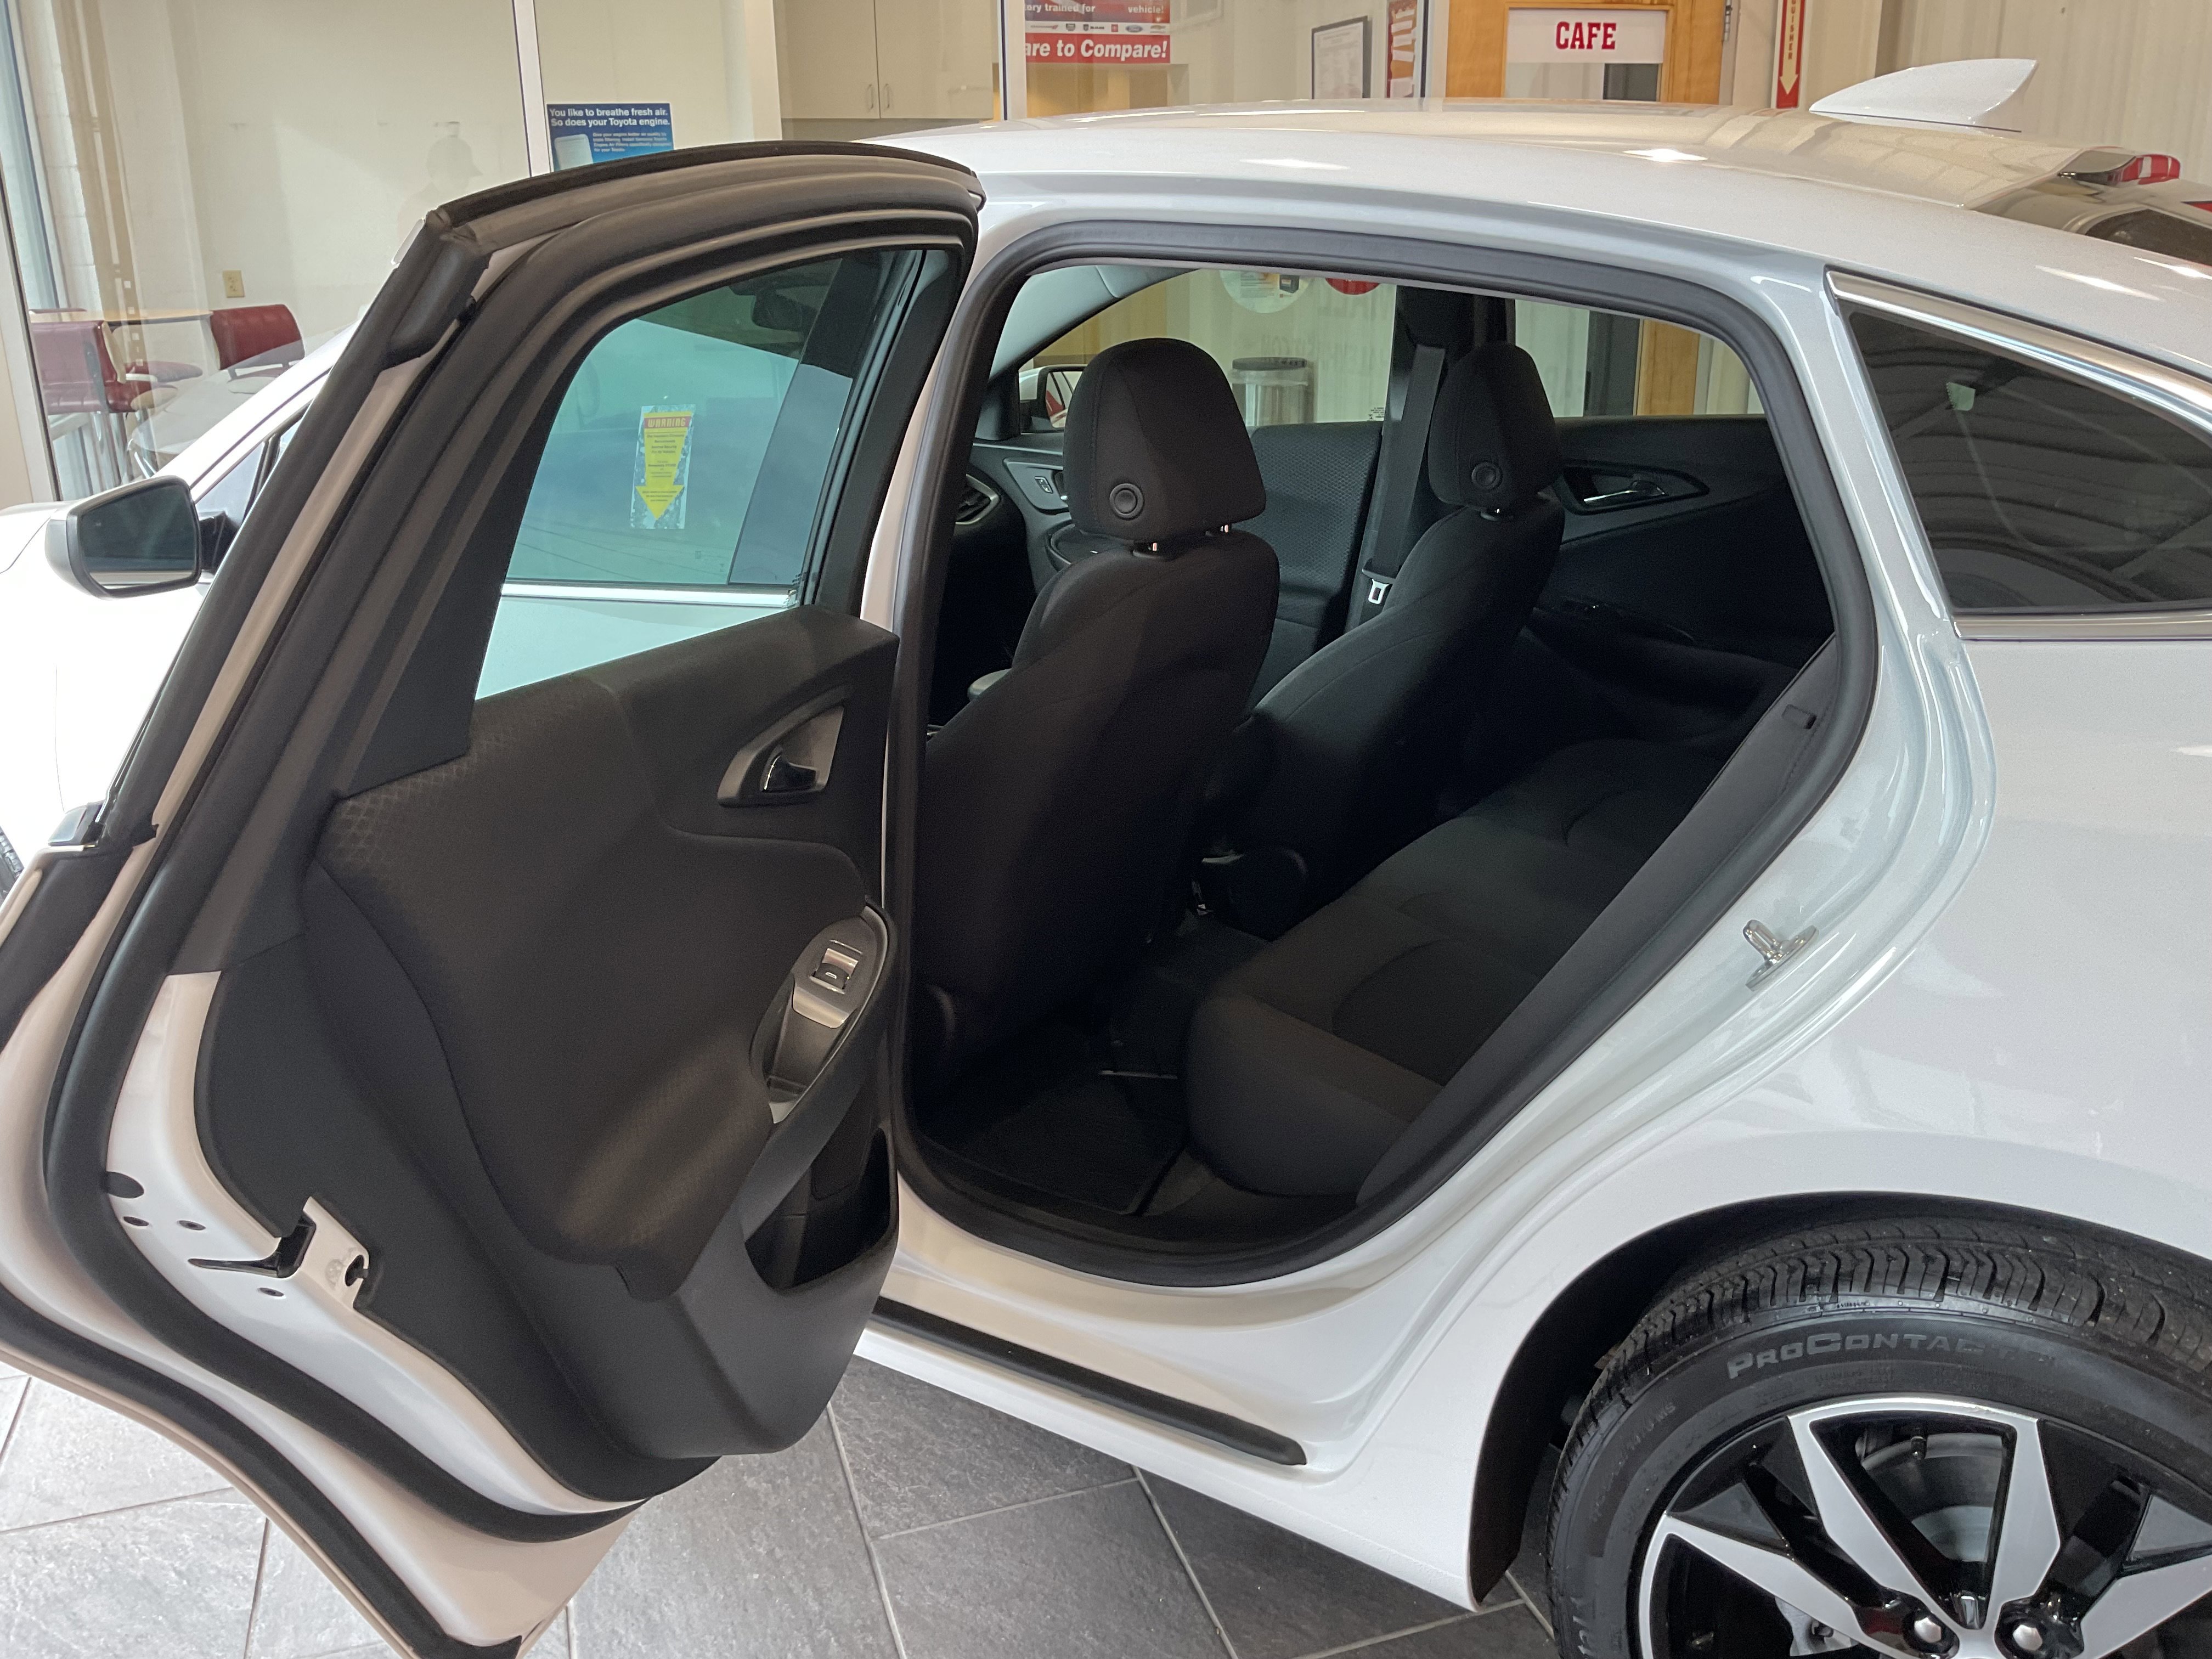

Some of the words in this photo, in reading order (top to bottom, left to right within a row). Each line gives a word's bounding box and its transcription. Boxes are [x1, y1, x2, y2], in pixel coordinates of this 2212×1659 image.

[1045, 3, 1079, 12] trained
[1082, 4, 1096, 12] for
[1128, 5, 1164, 14] vehicle!
[1556, 21, 1616, 49] CAFE
[1057, 40, 1075, 57] to
[1081, 39, 1167, 61] Compare!
[568, 108, 583, 116] like
[588, 119, 607, 127] your
[608, 117, 637, 127] Toyota
[639, 117, 670, 127] engine.
[648, 417, 685, 427] WARNING
